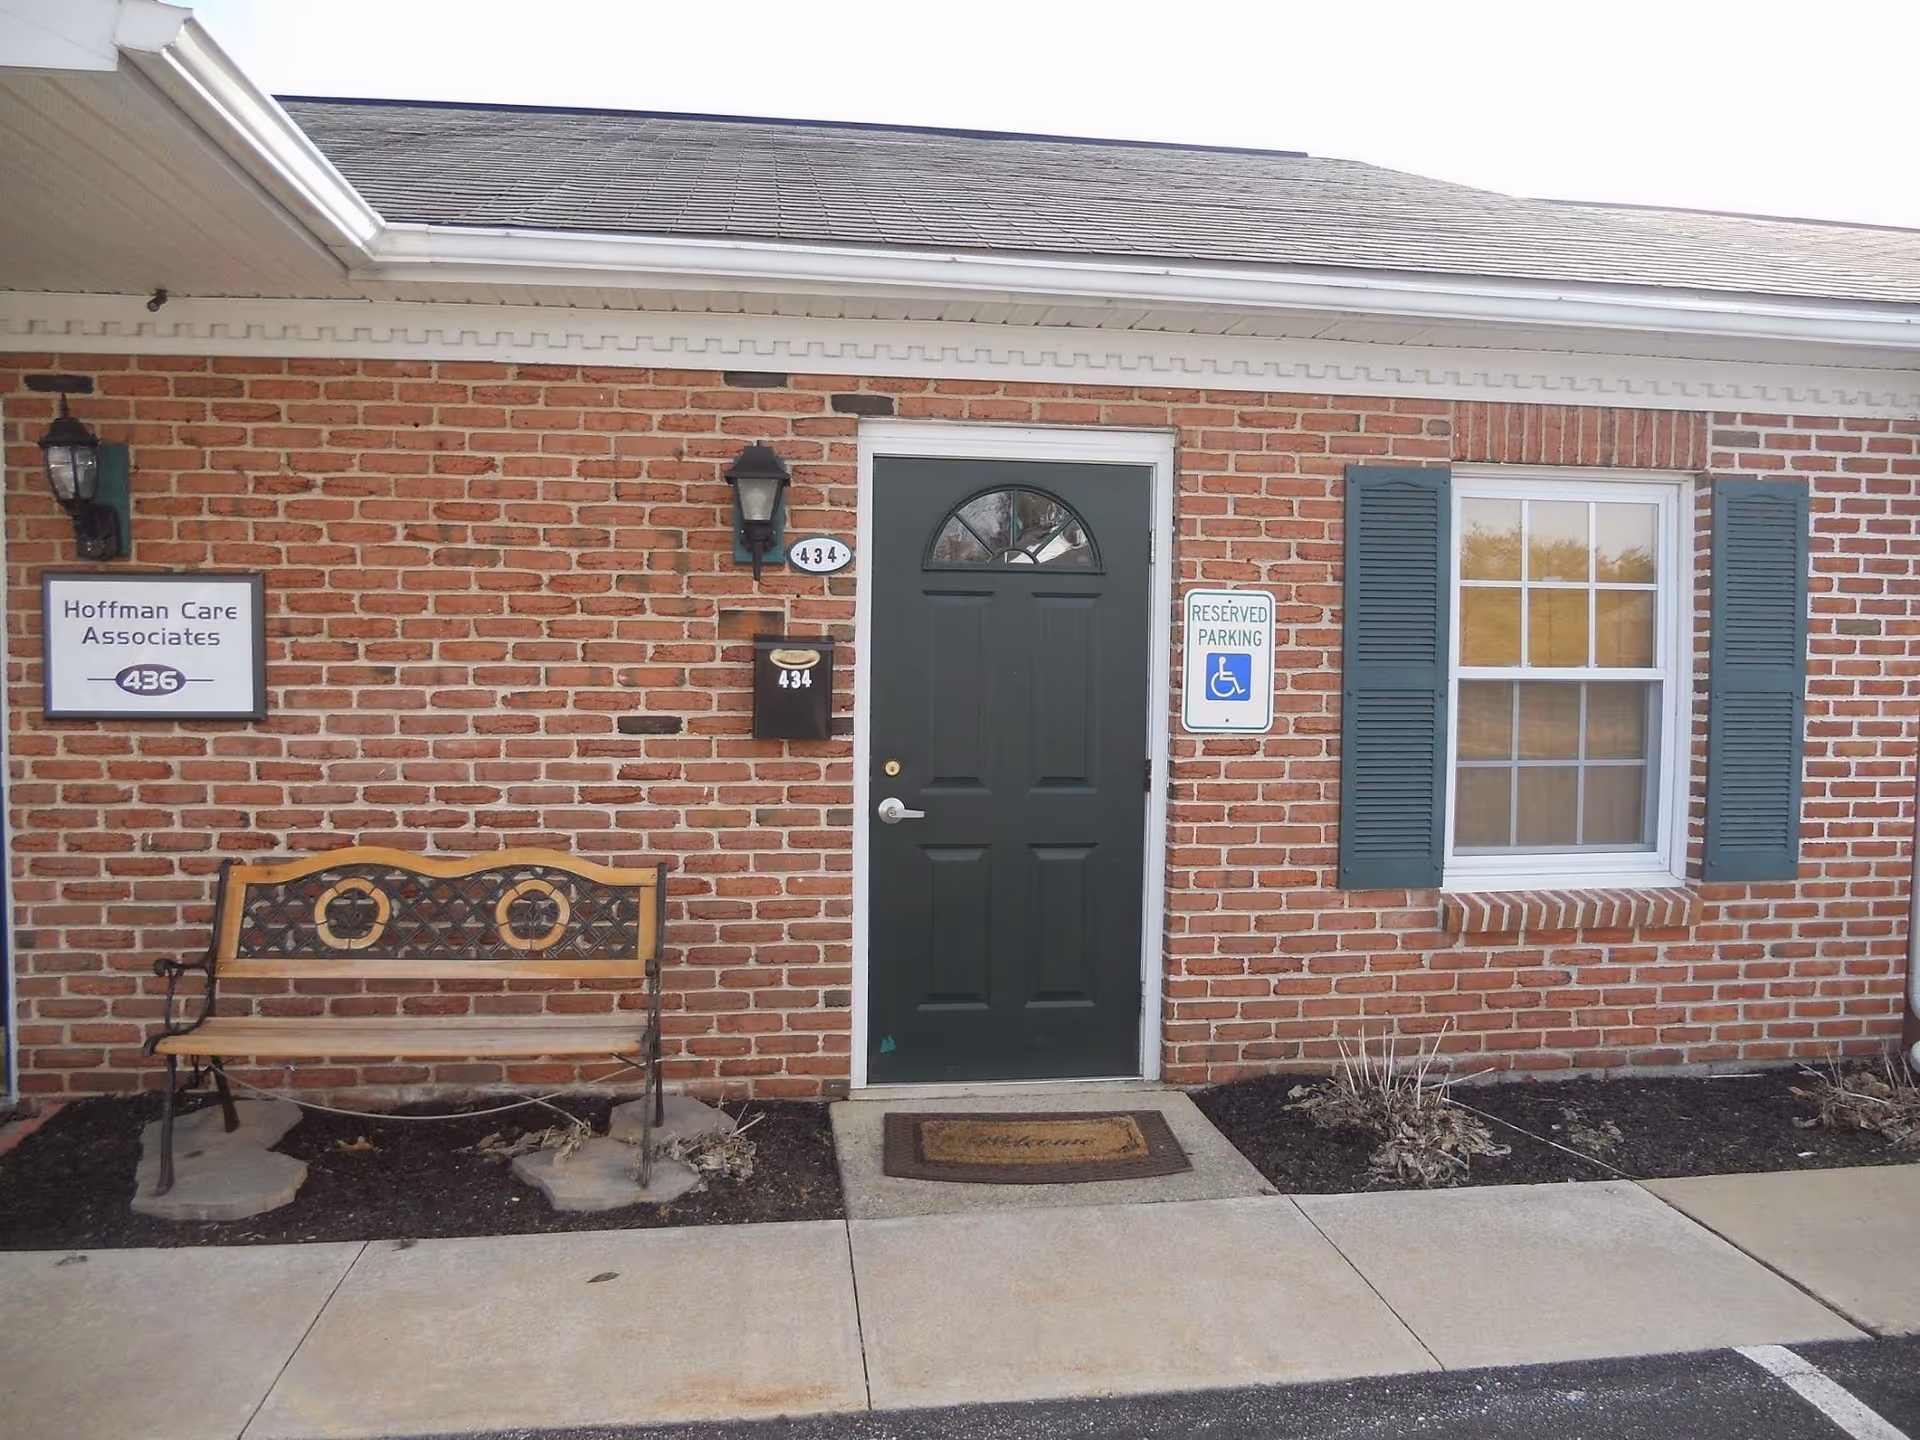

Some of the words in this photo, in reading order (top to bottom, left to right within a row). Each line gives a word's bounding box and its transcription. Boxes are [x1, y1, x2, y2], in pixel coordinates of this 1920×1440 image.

[799, 546, 838, 565] 434
[64, 599, 169, 619] Hoffman
[181, 601, 238, 620] Care
[1192, 604, 1268, 623] RESERVED
[81, 626, 221, 646] Associates
[1198, 628, 1262, 647] PARKING
[123, 670, 179, 690] 436
[778, 669, 813, 689] 434
